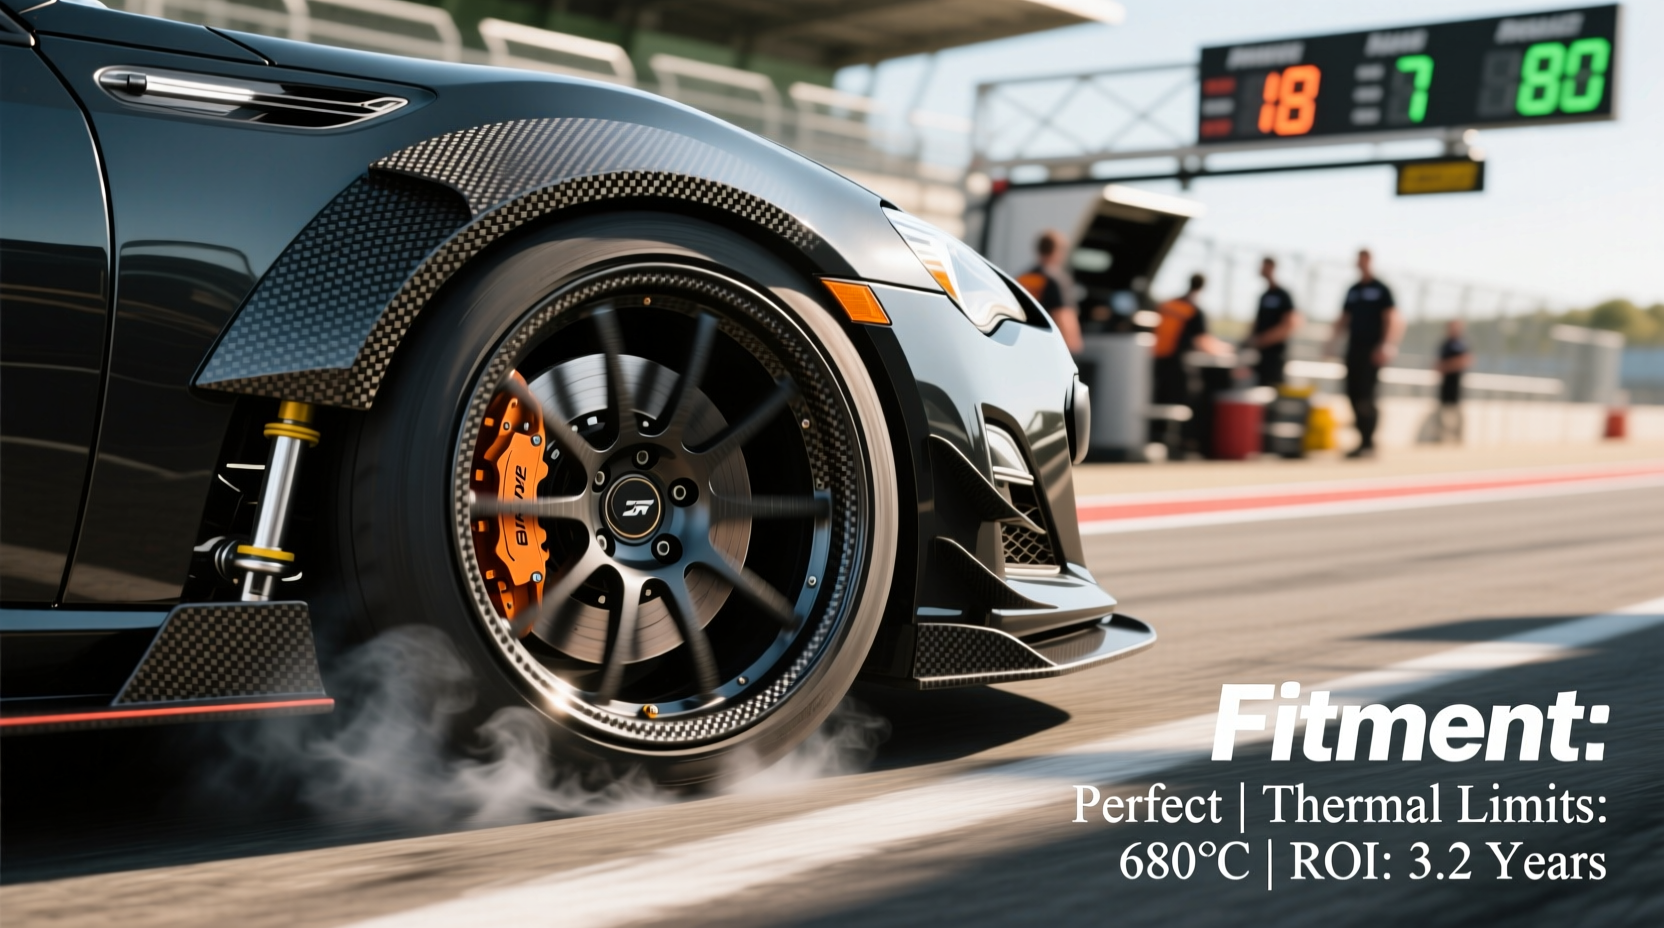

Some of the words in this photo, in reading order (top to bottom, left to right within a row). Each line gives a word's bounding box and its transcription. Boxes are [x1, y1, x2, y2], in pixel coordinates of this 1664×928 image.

[1257, 65, 1321, 136] 18
[1396, 55, 1434, 123] 7
[1516, 38, 1611, 116] 80
